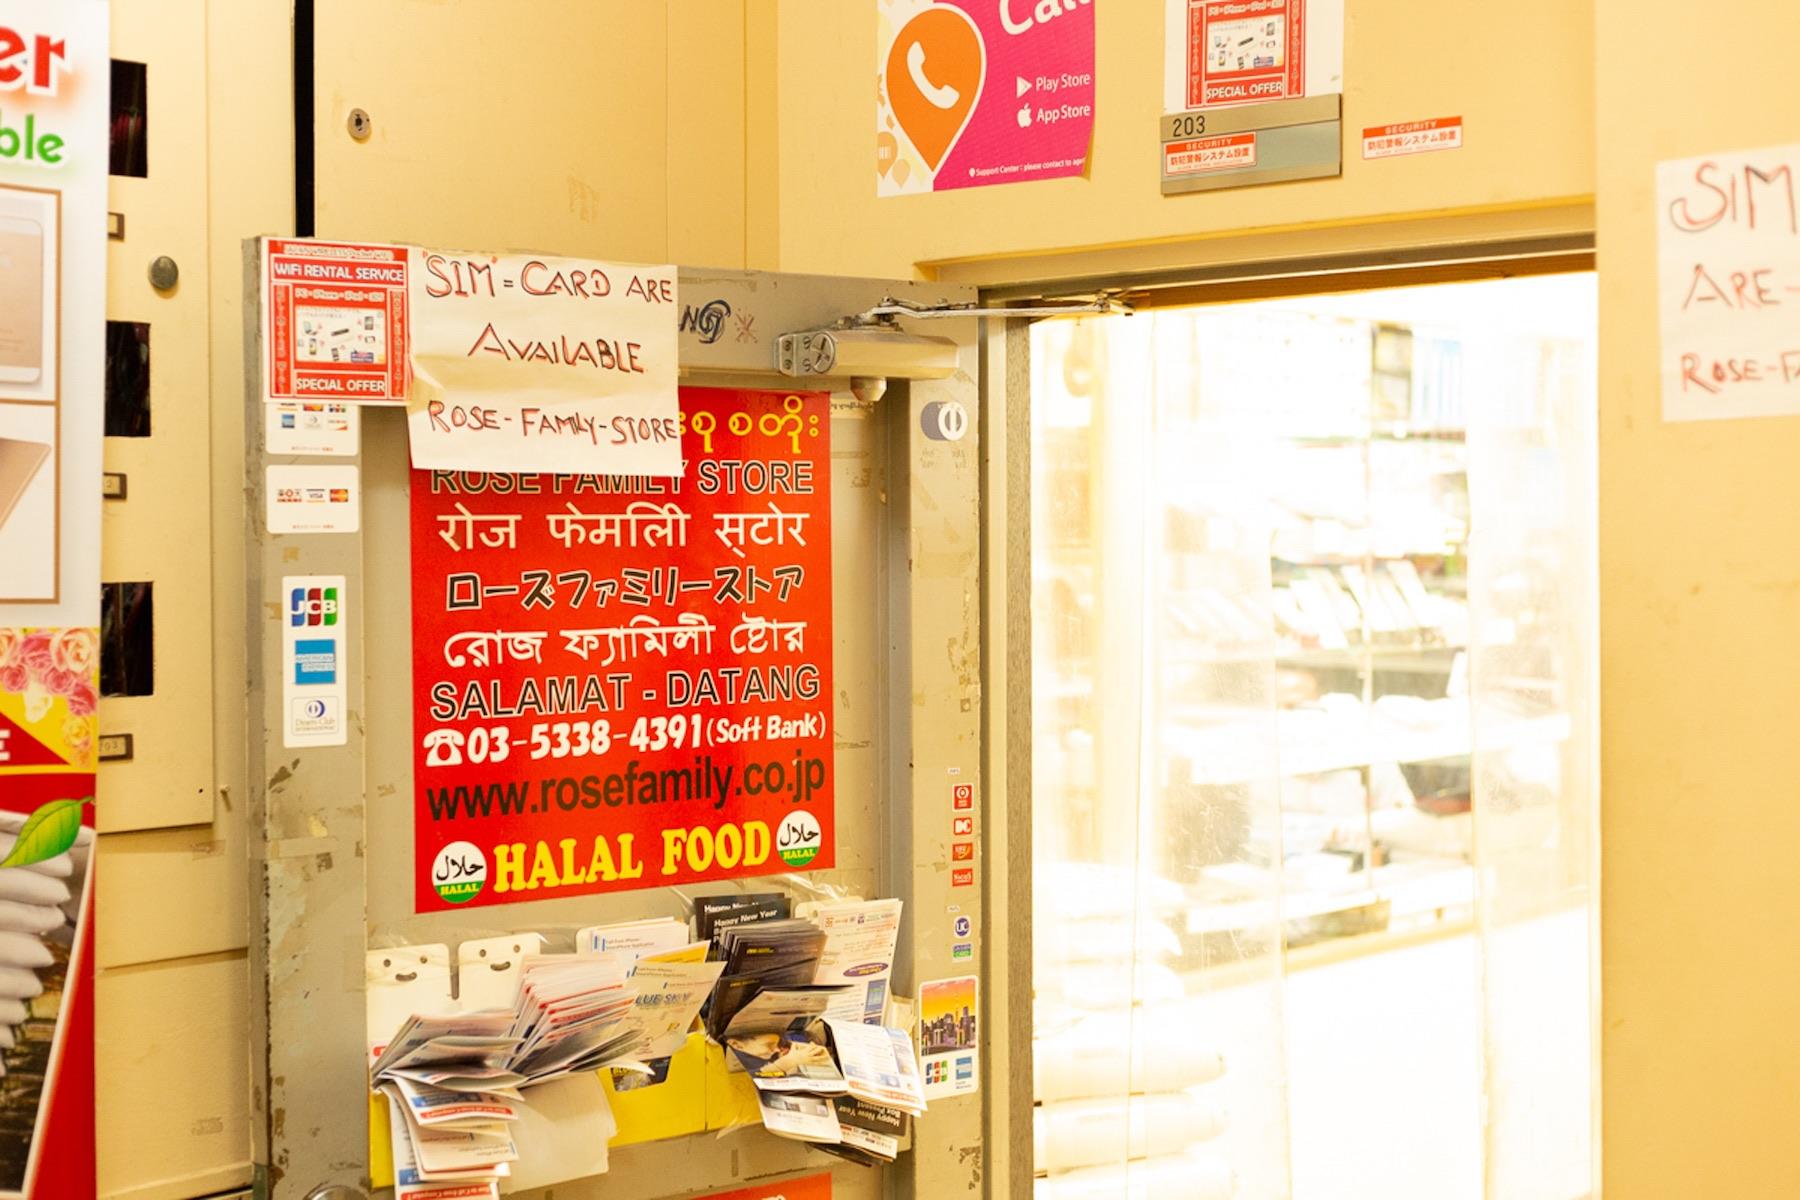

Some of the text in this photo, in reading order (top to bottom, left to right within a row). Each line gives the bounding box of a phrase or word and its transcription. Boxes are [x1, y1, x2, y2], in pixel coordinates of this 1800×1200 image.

[1036, 73, 1092, 94] Play Store
[1206, 81, 1283, 99] SPECIAL OFFER
[1036, 104, 1092, 125] App Store
[1172, 115, 1206, 137] 203
[1384, 120, 1438, 135] SECURITY
[1185, 138, 1233, 151] SECURITY
[1669, 162, 1798, 234] SIM
[303, 263, 353, 280] RENTAL
[355, 267, 405, 282] SERVICE
[520, 260, 612, 300] CARD
[625, 274, 674, 304] ARE
[467, 322, 646, 374] AVAILABLE
[296, 377, 386, 393] SPECIAL OFFER
[431, 466, 541, 495] ROSE
[698, 460, 814, 495] STORE
[436, 502, 523, 552] रोज
[445, 565, 806, 612] ローズファミリーストア
[430, 674, 634, 722] SALAMAT
[666, 662, 822, 709] DATANG
[466, 713, 702, 764] 03-5338-4391
[426, 748, 827, 822] www.rosefamily.co.jp
[492, 819, 772, 894] HALAL FOOD
[783, 846, 816, 861] HALAL
[439, 882, 480, 897] HALAL
[759, 909, 778, 919] Year
